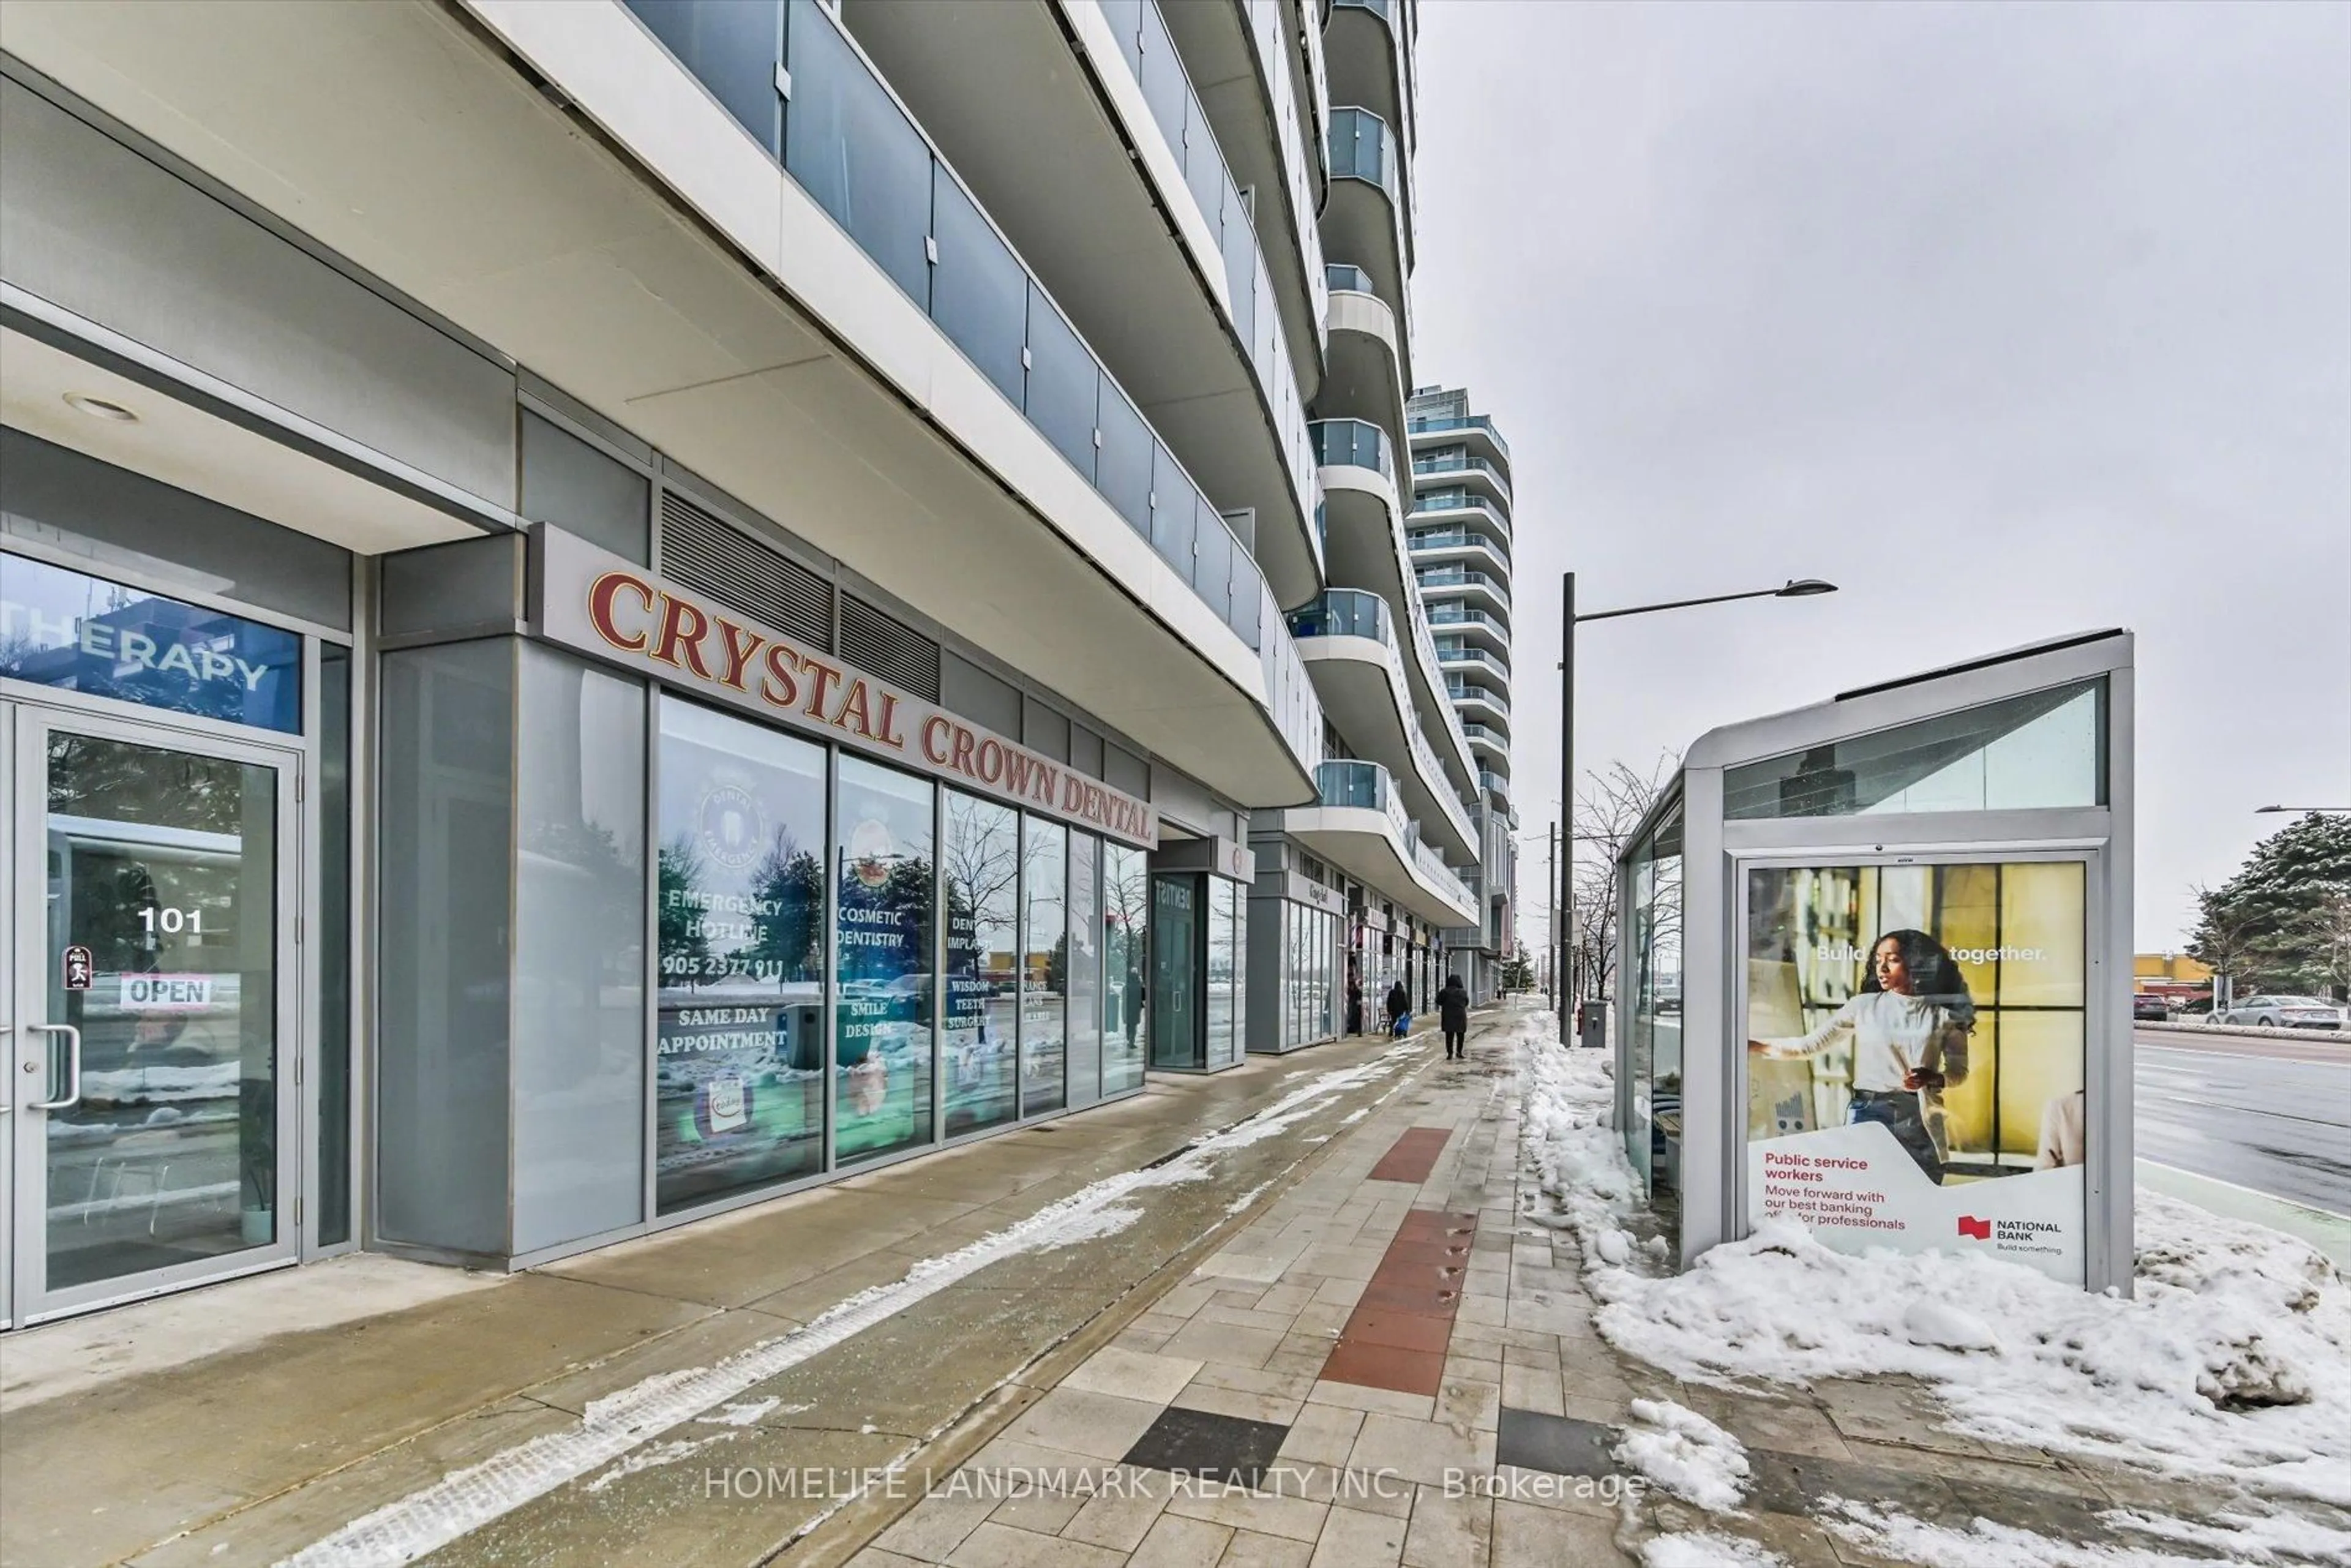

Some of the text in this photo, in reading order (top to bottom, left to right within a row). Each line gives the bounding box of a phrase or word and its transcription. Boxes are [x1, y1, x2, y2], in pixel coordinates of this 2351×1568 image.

[588, 571, 1151, 840] CRYSTAL CROWN DENTAL
[669, 890, 783, 917] EMERGENCY
[138, 907, 201, 933] 101
[838, 907, 902, 926] COSMETIC
[685, 920, 769, 942] HOTLINE
[836, 929, 904, 947] DENTISTRY
[1818, 945, 2046, 964] Build together.
[662, 956, 700, 975] 905
[130, 980, 204, 1003] OPEN
[952, 981, 989, 992] WISDOM
[851, 1002, 888, 1016] SMILE
[955, 997, 986, 1010] TEETH
[678, 1008, 770, 1026] SAME DAY
[948, 1015, 991, 1029] SURGERY
[846, 1023, 893, 1038] DESIGN
[657, 1031, 787, 1054] APPOINTMENT
[1765, 1153, 1868, 1170] Public service
[1765, 1169, 1823, 1182] workers
[1765, 1185, 1884, 1203] Move forward with
[1765, 1199, 1873, 1217] our best banking
[1818, 1215, 1906, 1231] professionals
[1997, 1220, 2061, 1232] NATIONAL
[1998, 1230, 2033, 1241] BANK
